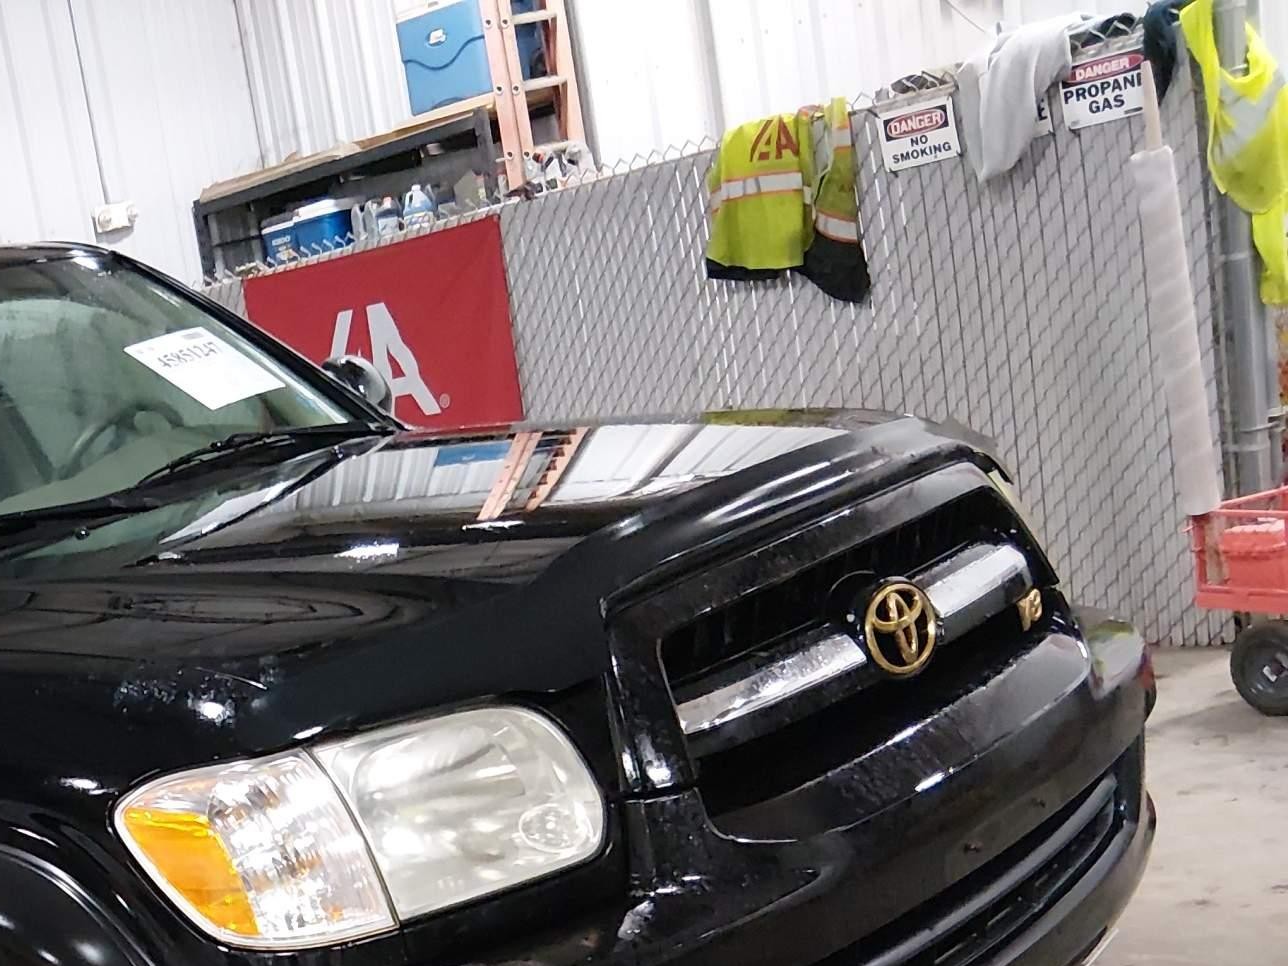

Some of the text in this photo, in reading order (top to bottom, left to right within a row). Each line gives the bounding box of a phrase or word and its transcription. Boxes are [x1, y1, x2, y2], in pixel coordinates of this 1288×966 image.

[1075, 58, 1129, 80] DANGER
[1089, 95, 1125, 114] GAS
[891, 113, 941, 135] DANGER
[910, 135, 929, 147] NO
[892, 142, 951, 164] SMOKING
